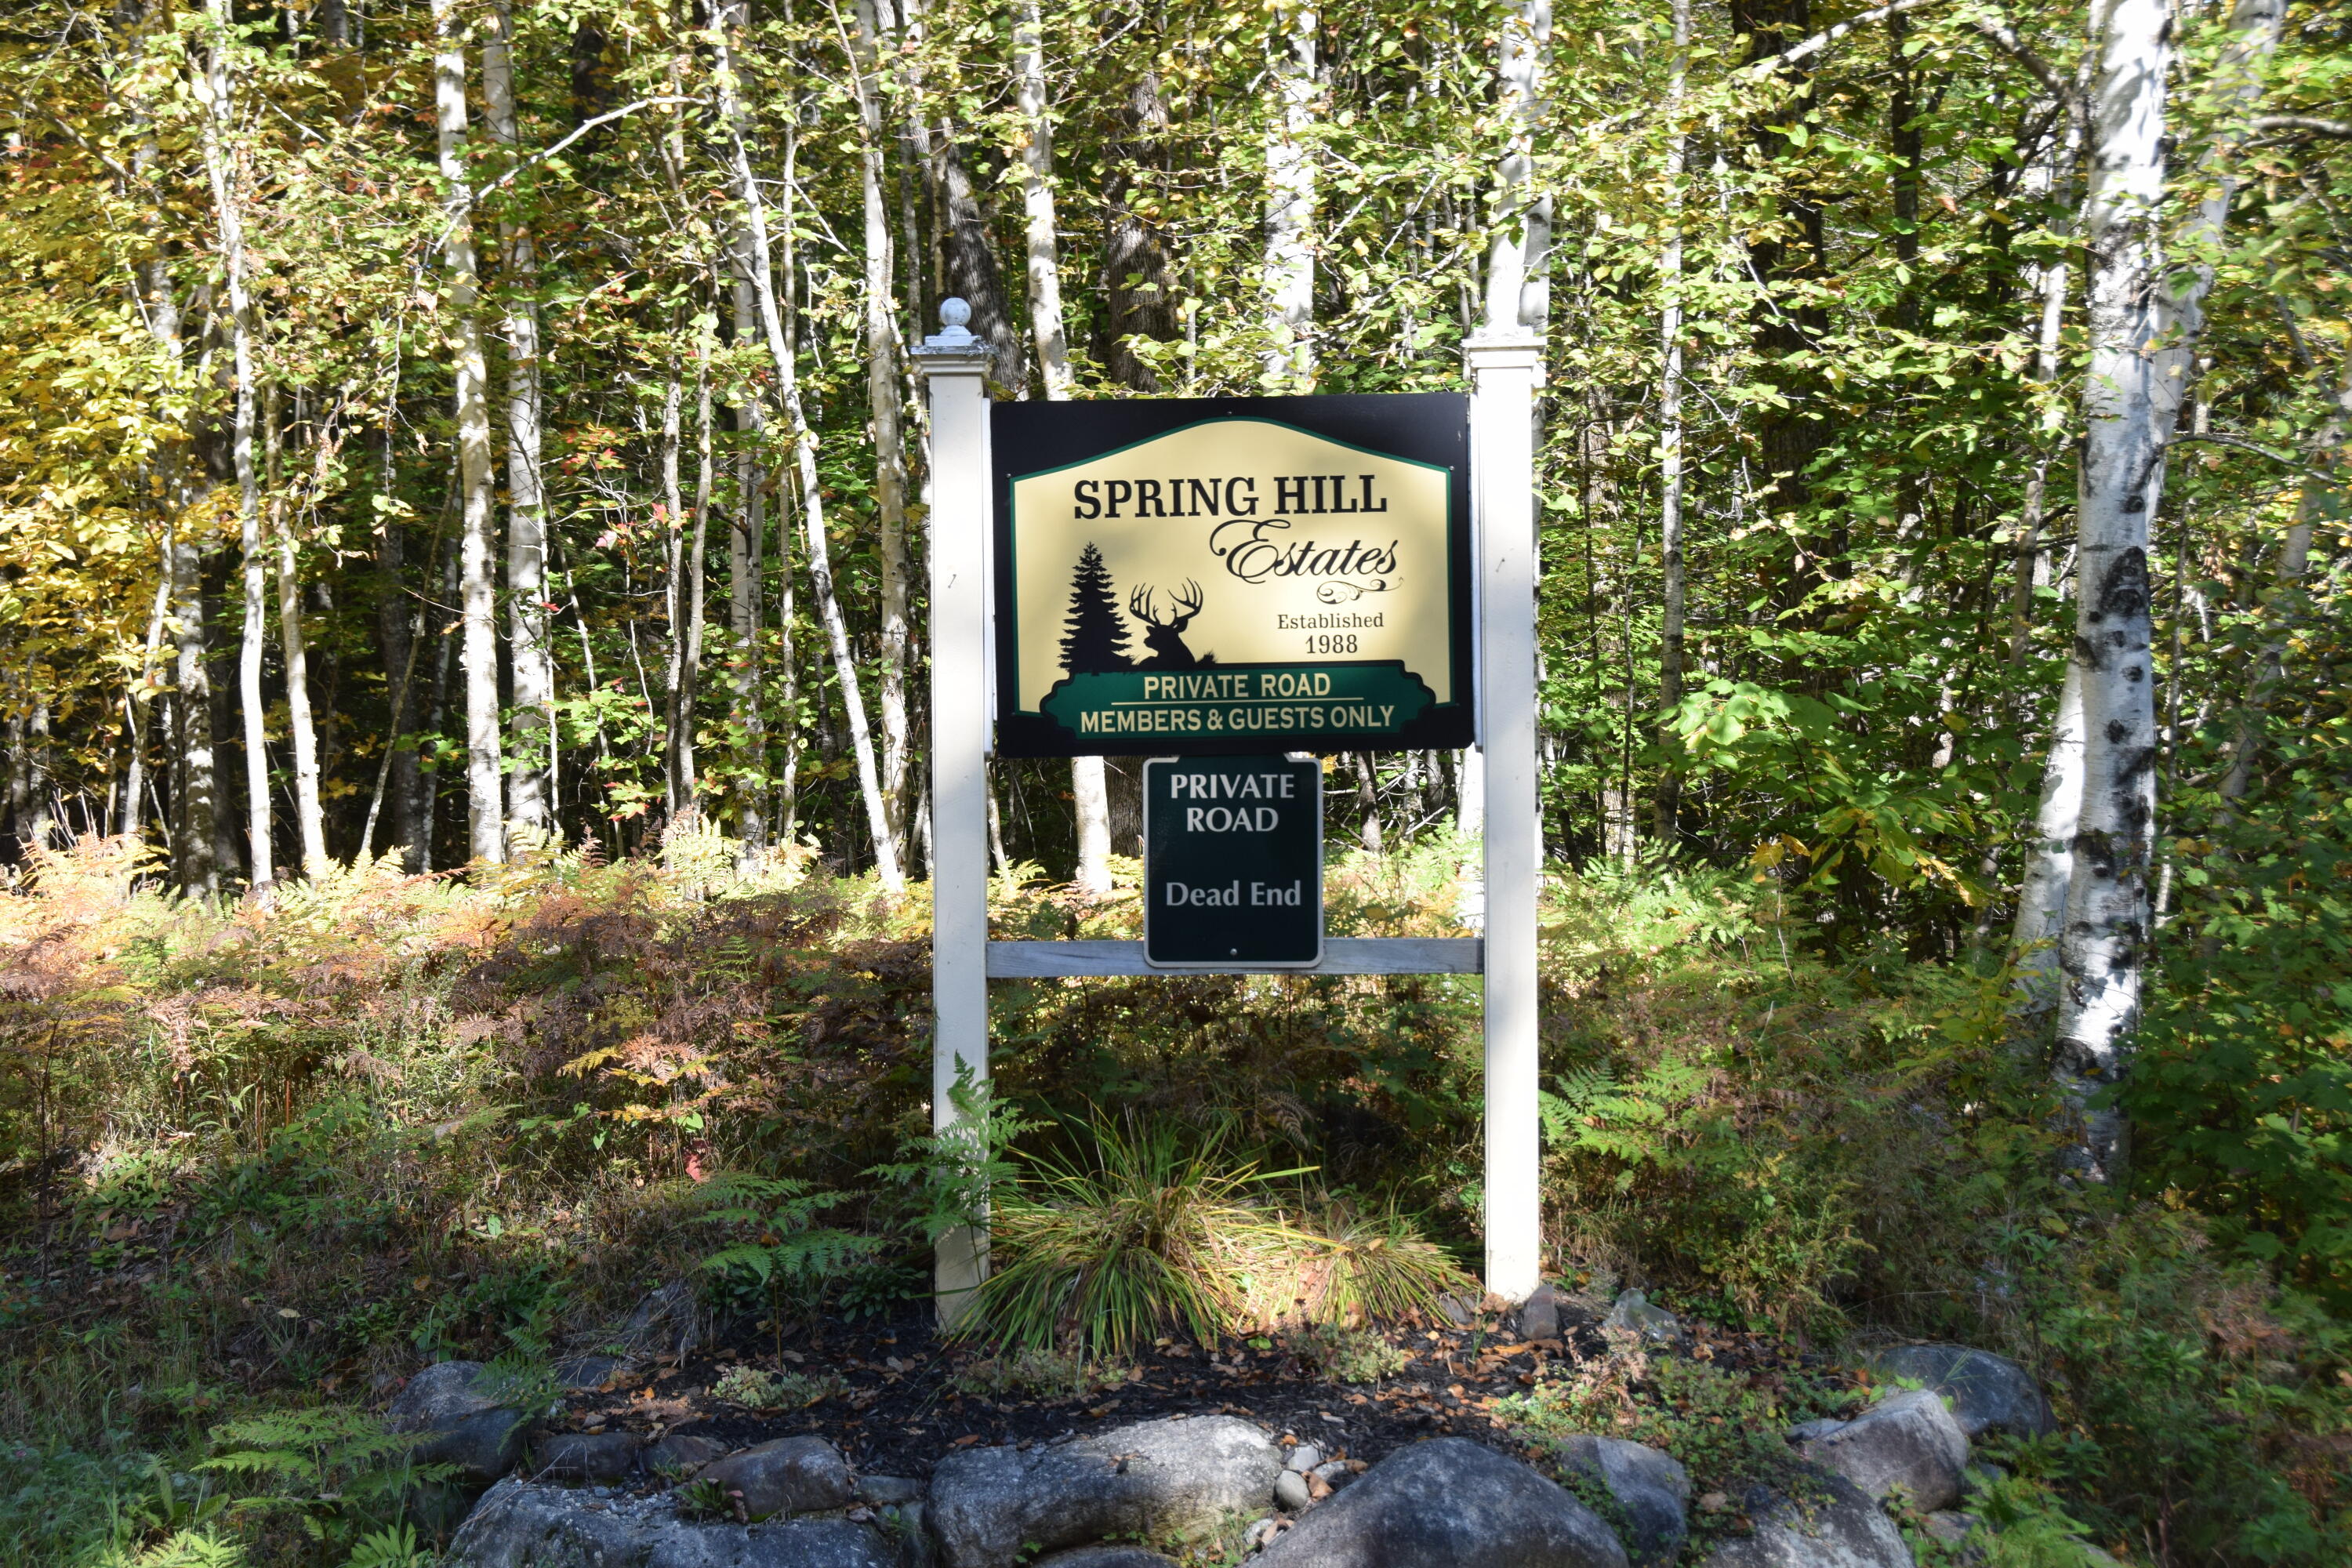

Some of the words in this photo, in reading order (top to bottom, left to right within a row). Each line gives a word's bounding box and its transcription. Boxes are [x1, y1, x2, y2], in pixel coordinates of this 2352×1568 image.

[1073, 477, 1259, 521] SPRING
[1273, 474, 1388, 515] HILL
[1210, 518, 1399, 584] Estates
[1277, 612, 1385, 630] Established
[1305, 634, 1359, 655] 1988
[1143, 674, 1249, 700] PRIVATE
[1261, 673, 1331, 697] ROAD
[1080, 710, 1201, 733] MEMBERS
[1207, 710, 1224, 731] &
[1229, 707, 1325, 730] GUESTS
[1330, 706, 1395, 728] ONLY
[1171, 774, 1294, 799] PRIVATE
[1186, 807, 1279, 832] ROAD
[1166, 880, 1240, 906] Dead
[1250, 880, 1301, 906] End
